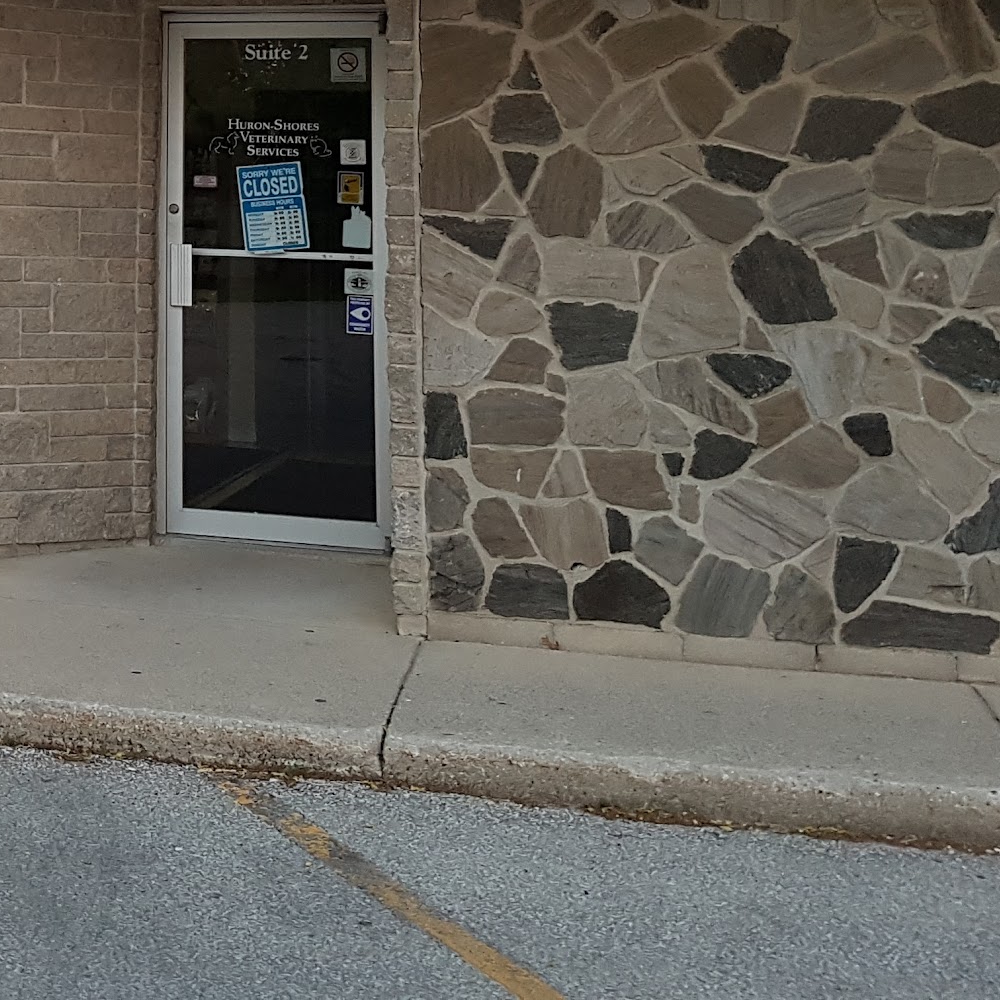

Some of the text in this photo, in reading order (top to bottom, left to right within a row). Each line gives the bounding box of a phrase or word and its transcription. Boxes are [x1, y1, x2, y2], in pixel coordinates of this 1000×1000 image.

[245, 43, 309, 60] Suite 2
[228, 118, 320, 131] HURON-SHORES
[240, 131, 308, 144] VETERINARY
[246, 144, 299, 157] SERVICES
[242, 167, 297, 179] SORRY WE'RE
[243, 175, 298, 197] CLOSED
